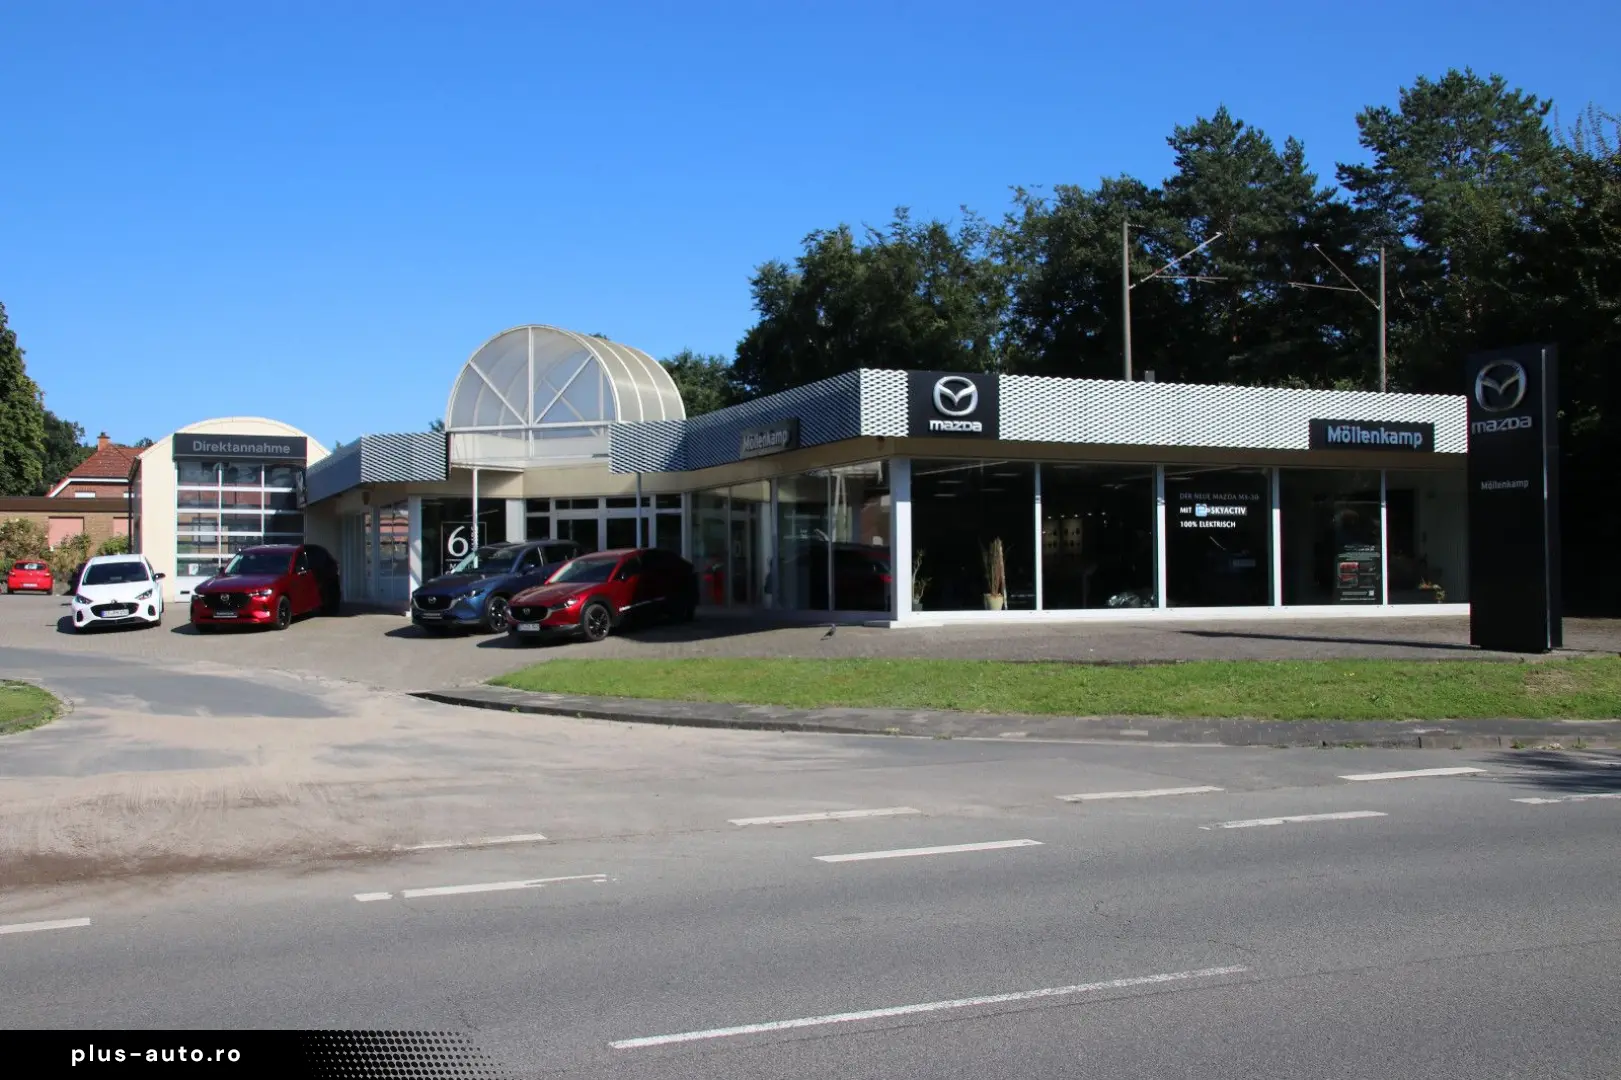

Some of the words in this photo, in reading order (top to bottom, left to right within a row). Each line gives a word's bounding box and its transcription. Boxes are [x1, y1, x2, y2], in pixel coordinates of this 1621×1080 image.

[929, 420, 982, 432] mazda
[1472, 416, 1532, 434] mazda
[1327, 425, 1423, 447] Möllenkamp
[193, 440, 290, 454] Direktannahme
[1481, 479, 1529, 490] Möllenkamp
[1179, 506, 1192, 514] MIT
[1180, 520, 1198, 528] 100%
[1199, 520, 1236, 528] ELEKTRISCH
[447, 525, 469, 557] 6
